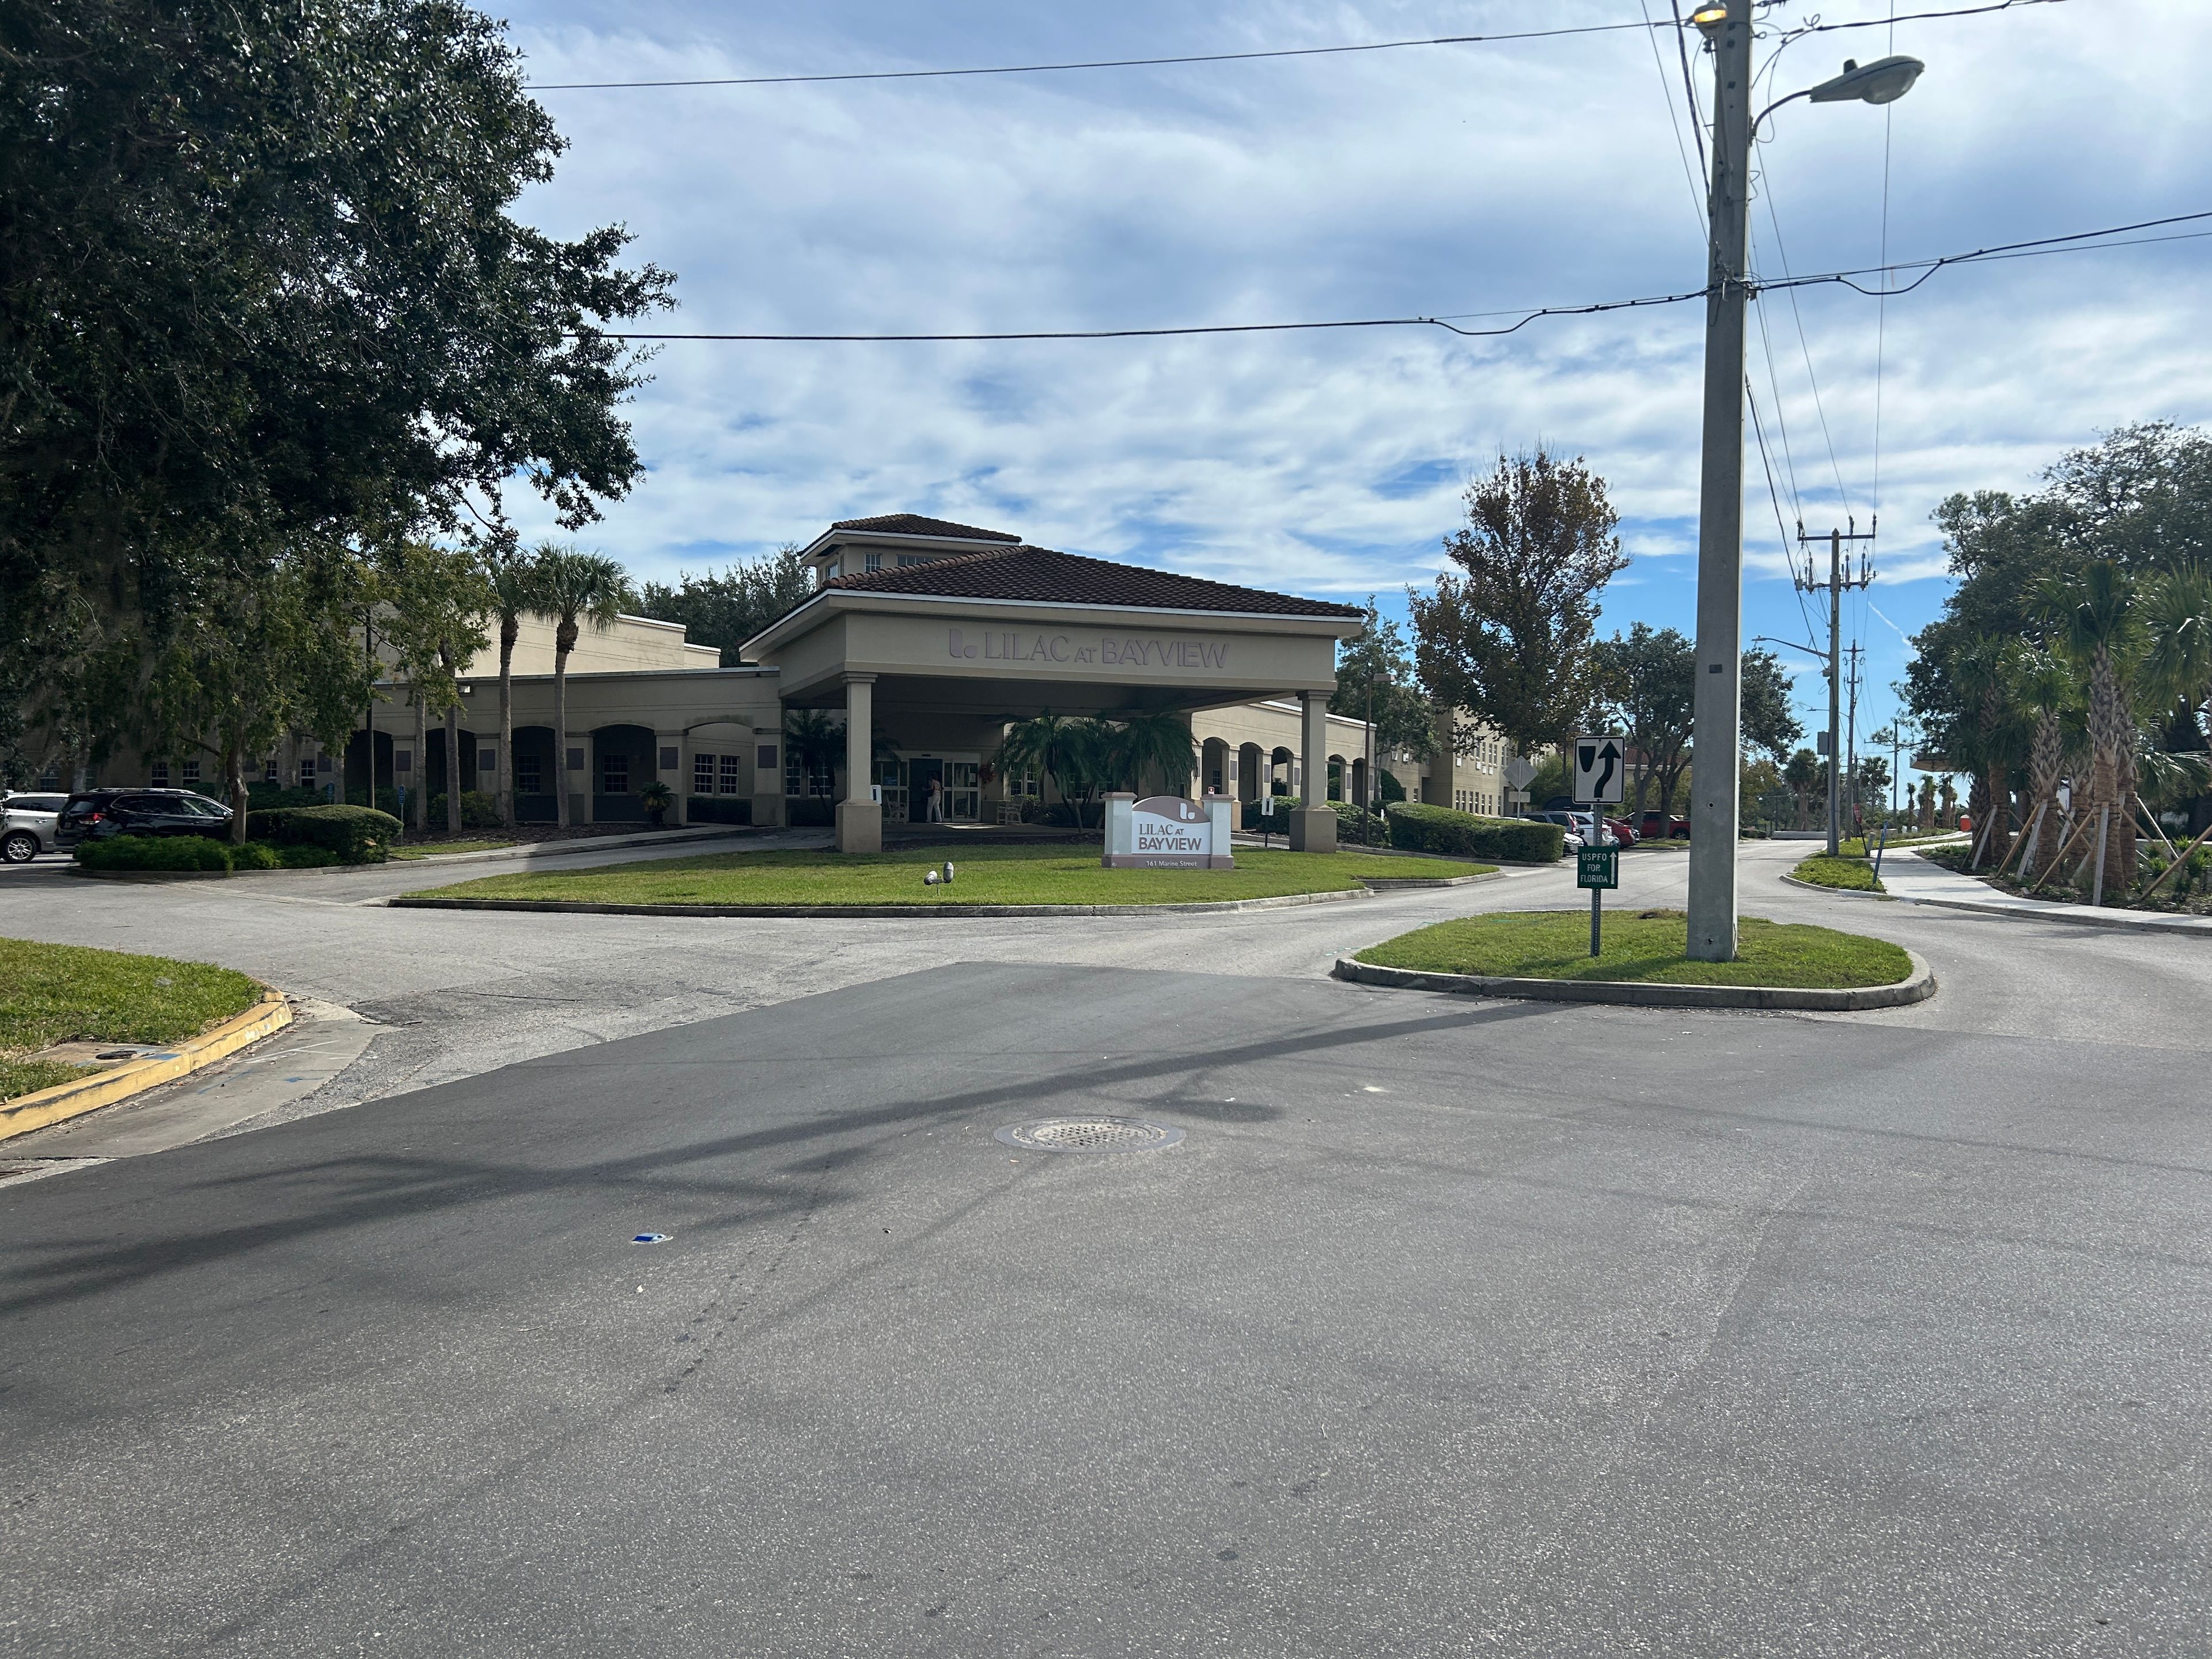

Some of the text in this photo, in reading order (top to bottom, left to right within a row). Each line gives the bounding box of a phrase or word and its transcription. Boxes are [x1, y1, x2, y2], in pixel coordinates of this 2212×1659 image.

[985, 632, 1230, 668] LILAC AT BAYVIEW
[1139, 823, 1173, 835] LILAC
[1138, 837, 1202, 851] BAYVIEW
[1582, 853, 1607, 861] USPFO
[1587, 863, 1601, 872] FOR
[1580, 874, 1608, 883] FLORIDA
